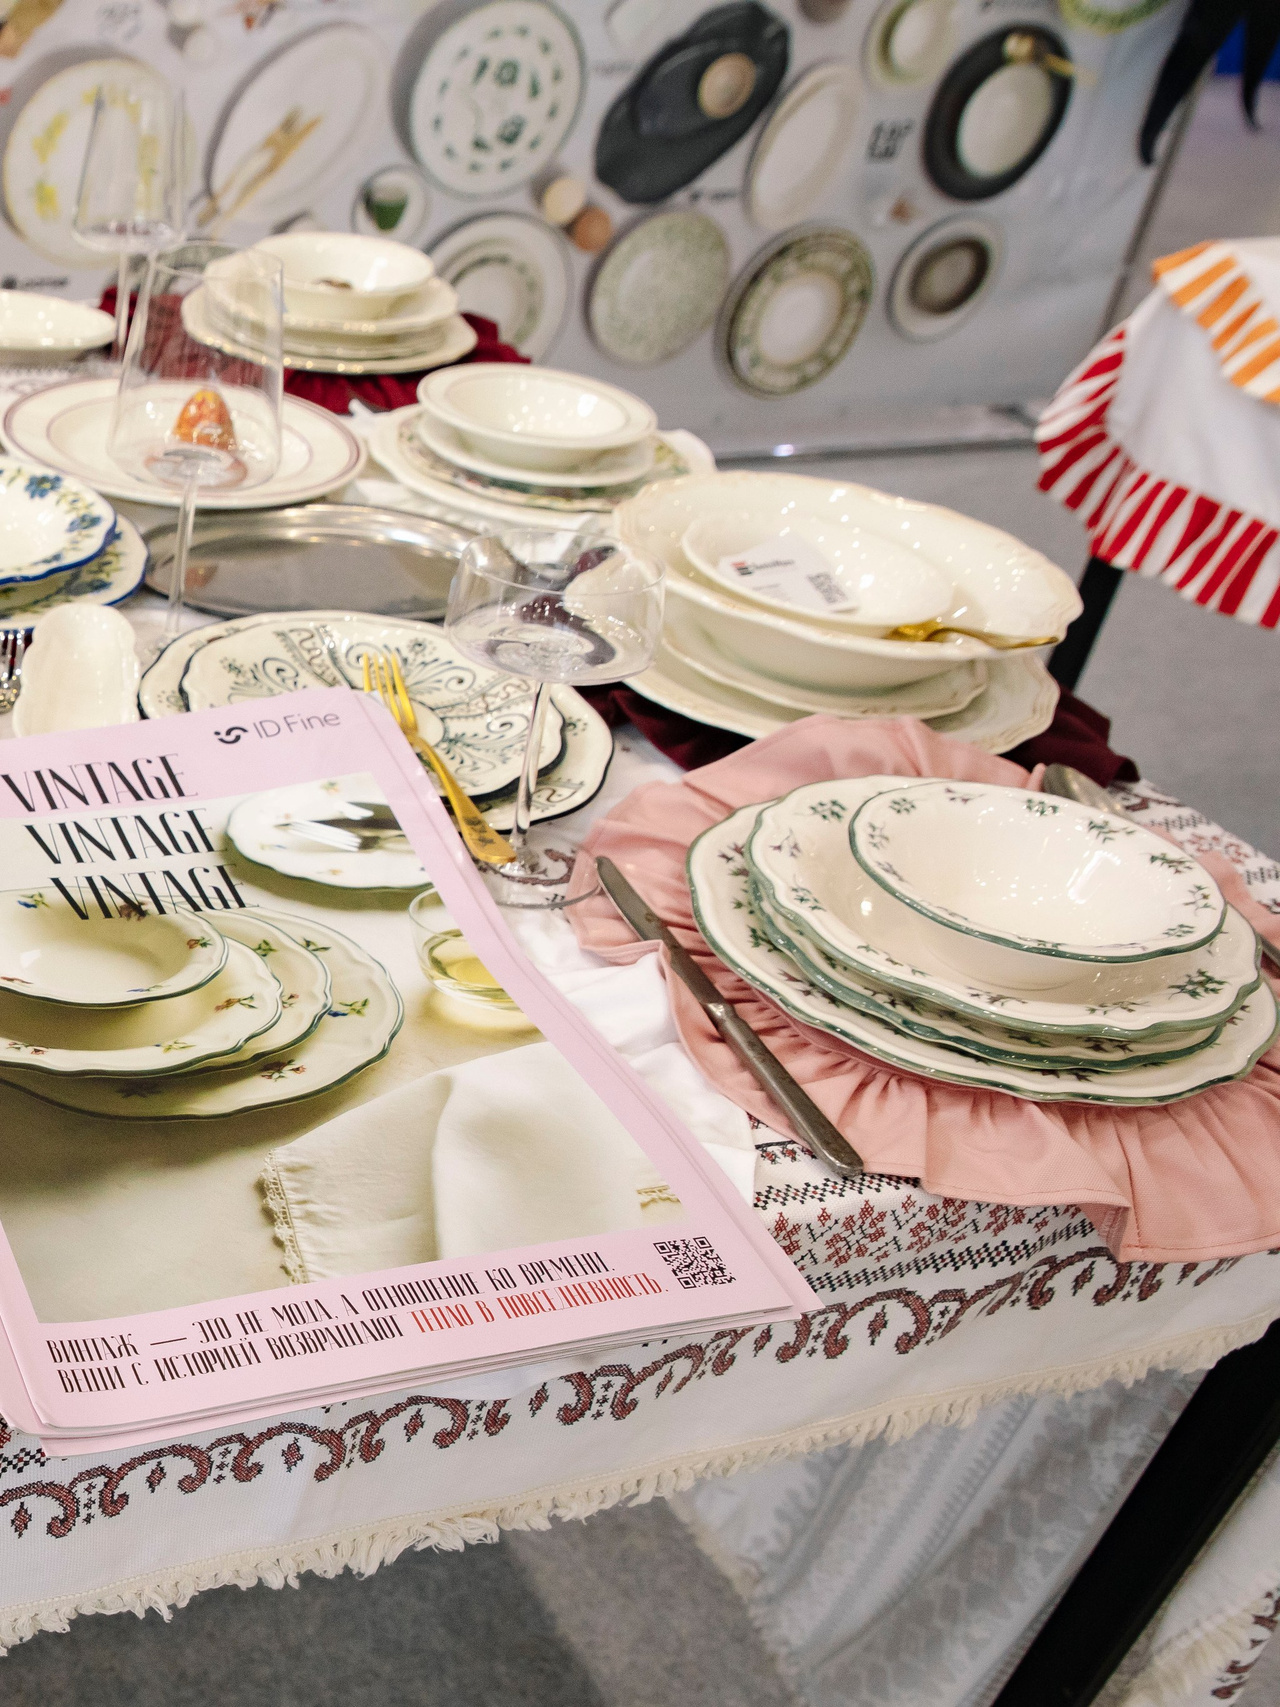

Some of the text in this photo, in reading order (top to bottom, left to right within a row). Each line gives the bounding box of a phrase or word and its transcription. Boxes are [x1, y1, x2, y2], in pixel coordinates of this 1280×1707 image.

[253, 713, 341, 739] ID Fine
[0, 753, 198, 812] VINTAGE
[23, 808, 227, 864] VINTAGE
[48, 863, 260, 920] VINTAGE
[46, 1333, 140, 1363] ВИНТАЖ
[192, 1316, 232, 1344] ЭТО
[235, 1309, 269, 1336] НЕ
[271, 1298, 339, 1329] МОДА,
[340, 1293, 360, 1317] А
[362, 1272, 485, 1312] ОТНОШЕНИЕ
[484, 1267, 517, 1292] КО
[517, 1251, 616, 1286] ВРЕМЕНИ.
[57, 1272, 669, 1393] ВЕЩИ С ИСТОРИЕЙ ВОЗВРАЩАЮТ ТЕПЛО В ПОВСЕДНЕВНОСТЬ.
